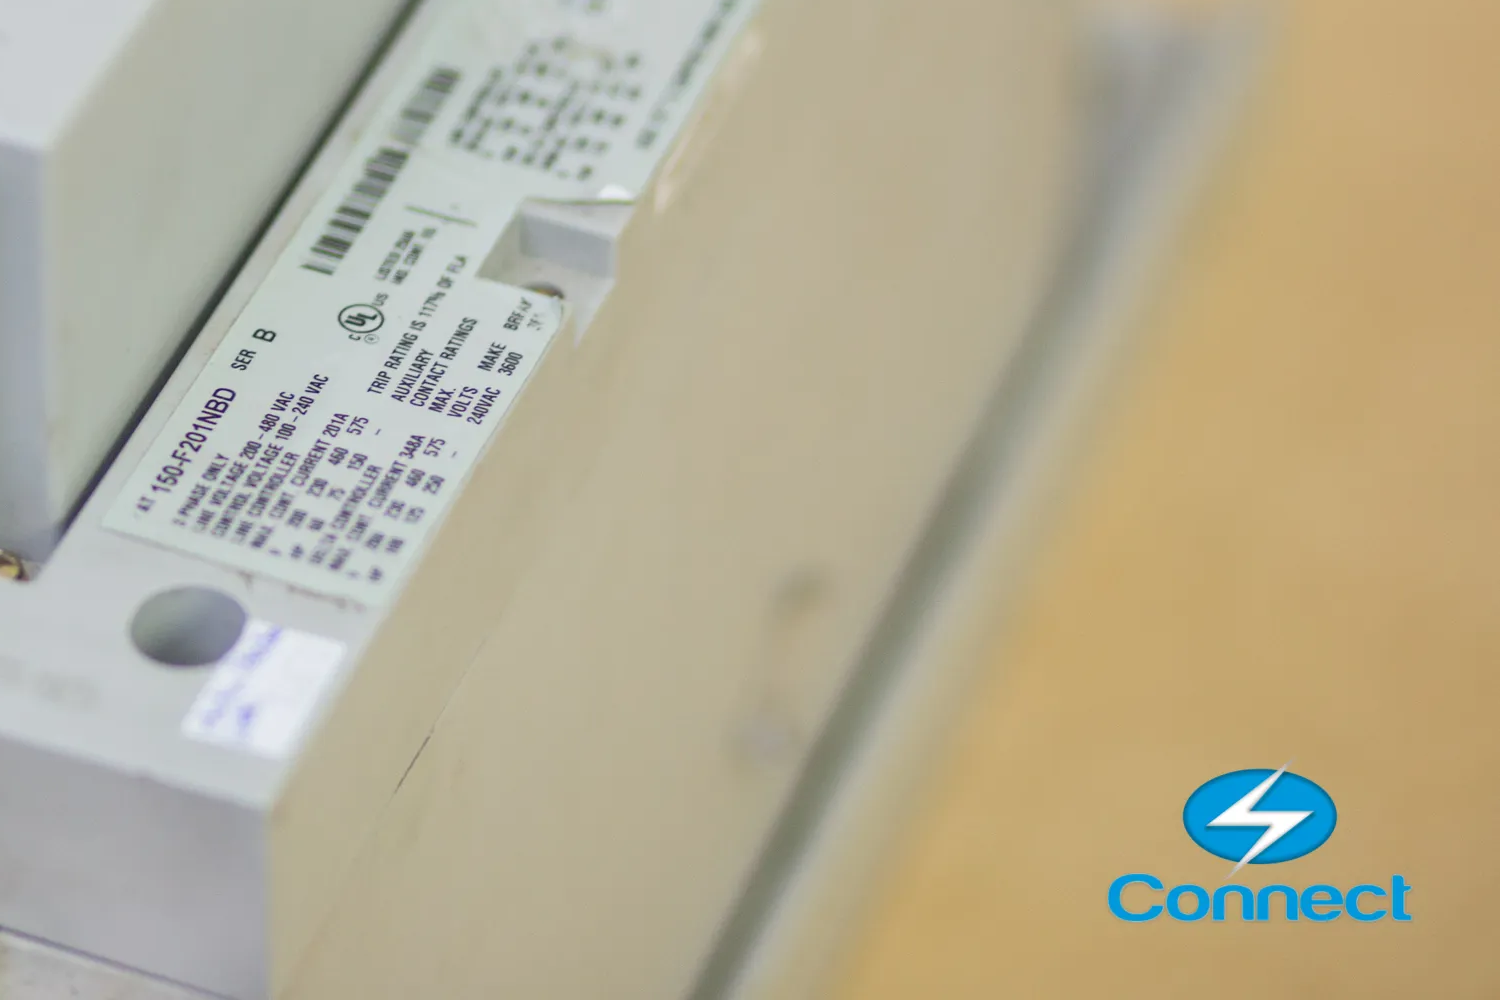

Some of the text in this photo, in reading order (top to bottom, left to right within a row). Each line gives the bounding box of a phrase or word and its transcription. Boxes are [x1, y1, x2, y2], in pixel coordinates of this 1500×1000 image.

[368, 371, 393, 394] TRIP
[385, 333, 418, 368] RATING
[410, 320, 426, 330] IS
[418, 290, 446, 317] 117%
[437, 275, 455, 288] OF
[411, 318, 476, 405] CONTACT RATINGS
[151, 387, 236, 493] 150-F201NBD
[231, 349, 256, 370] SER
[252, 328, 277, 341] B
[392, 350, 434, 400] AUXILIARY
[429, 386, 456, 412] MAX.
[448, 386, 478, 417] VOLTS
[478, 342, 506, 370] MAKE
[466, 351, 524, 424] 240VAC 3600
[201, 452, 230, 480] ONLY
[209, 462, 247, 504] VOLTAGE
[239, 440, 262, 459] 200
[257, 413, 280, 432] 480
[271, 391, 295, 411] VAC
[244, 444, 283, 487] VOLTAGE
[275, 423, 296, 440] 100
[292, 396, 314, 414] 240
[305, 374, 329, 394] VAC
[290, 440, 329, 485] CURRENT
[322, 412, 348, 436] 201A
[327, 447, 349, 465] 460
[347, 416, 369, 434] 575
[347, 453, 368, 470] 150
[424, 437, 447, 456] 575
[248, 452, 299, 515] CONTROLLER
[369, 461, 407, 506] CURRENT
[399, 434, 425, 458] 348A
